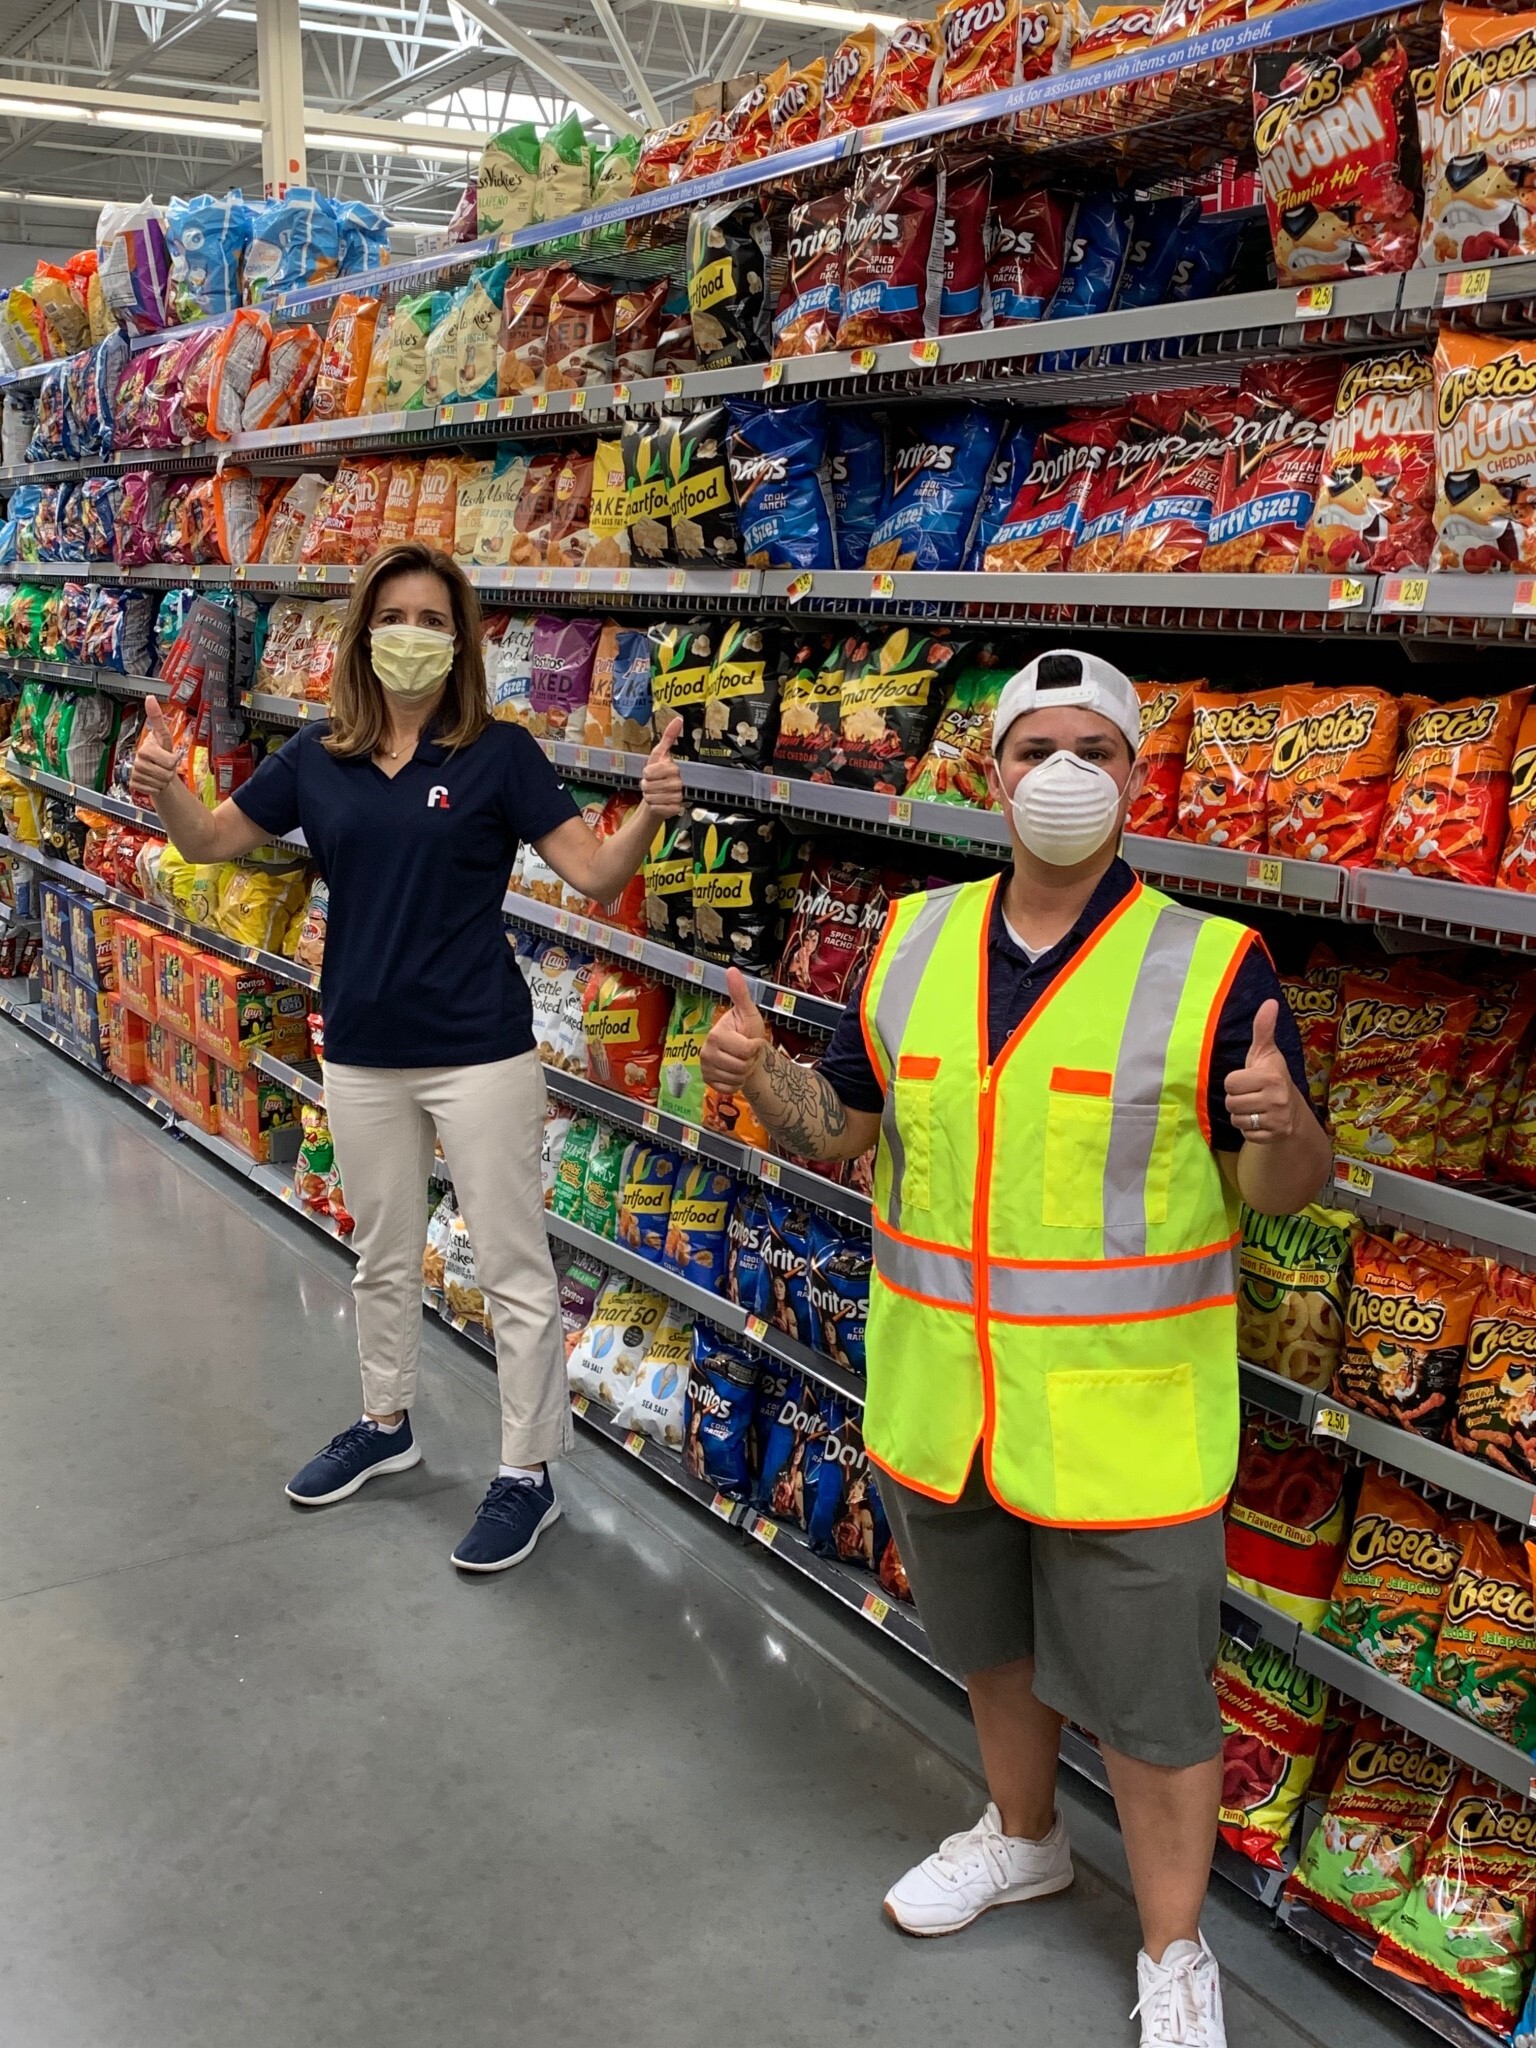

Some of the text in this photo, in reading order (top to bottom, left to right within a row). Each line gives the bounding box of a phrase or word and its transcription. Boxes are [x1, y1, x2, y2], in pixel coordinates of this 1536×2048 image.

[1005, 20, 1273, 108] Ask for assistance with items on the top shelf.
[1496, 133, 1536, 157] CHEDD
[1275, 162, 1369, 213] Flamin' Hot
[581, 215, 593, 228] Ask
[594, 211, 602, 223] for
[602, 204, 636, 221] assistance
[636, 198, 651, 213] with
[651, 193, 670, 208] items
[670, 190, 681, 202] on
[680, 187, 692, 199] the
[704, 174, 725, 192] shelf.
[847, 212, 900, 243] oritos
[825, 262, 840, 273] SPI
[866, 264, 894, 275] NACHO
[870, 255, 895, 265] SPICY
[998, 265, 1025, 276] SPICY
[992, 272, 1023, 284] NACHO
[1464, 272, 1486, 295] 2.50
[850, 283, 882, 312] Size!
[1336, 351, 1435, 417] Cheetos
[1023, 444, 1106, 486] Doritos
[1331, 444, 1382, 468] Flamin'
[1487, 448, 1536, 474] CHEDDA
[913, 487, 940, 498] RANCH
[921, 479, 941, 489] COOL
[759, 499, 787, 511] RANCH
[764, 493, 787, 503] COOL
[1250, 491, 1299, 520] Size!
[894, 505, 923, 531] Size!
[752, 518, 779, 546] Size!
[1404, 581, 1424, 601] 2.50
[531, 672, 573, 694] AKED
[1269, 701, 1378, 777] Cheetos
[1295, 757, 1345, 785] Crunchy
[1262, 863, 1279, 882] 2.50
[823, 937, 853, 950] NACHO
[830, 930, 855, 942] SPICY
[237, 978, 266, 991] Doritos
[530, 976, 562, 997] Kettle
[531, 998, 562, 1015] ooked
[562, 1011, 585, 1031] ooked
[1338, 998, 1447, 1049] Cheetos
[1352, 1165, 1371, 1187] 2.50
[623, 1188, 664, 1211] artfood
[760, 1233, 807, 1277] Dorito
[1240, 1256, 1326, 1285] nion Flavored Rings
[1365, 1273, 1391, 1285] TWICE
[561, 1287, 585, 1306] Doritos
[593, 1305, 658, 1326] mart 50
[1347, 1286, 1445, 1341] Cheetos
[847, 1333, 865, 1341] RAN
[581, 1359, 604, 1375] SEA SALT
[642, 1399, 669, 1417] SEA SALT
[778, 1400, 828, 1434] Dorito
[710, 1421, 730, 1432] COOL
[1327, 1410, 1345, 1431] 2.50
[1230, 1504, 1313, 1543] nion Flavored Rings
[1348, 1516, 1458, 1578] Cheetos
[1386, 1573, 1441, 1596] Jalapeño
[1370, 1588, 1403, 1603] Crunchy
[1448, 1568, 1536, 1627] Cheeto
[1481, 1630, 1536, 1651] Jalapeñ
[1465, 1644, 1500, 1659] Crunchy
[1254, 1707, 1290, 1734] Hot
[1347, 1740, 1455, 1793] Cheetos
[1339, 1795, 1408, 1814] Flamin' Hot
[1488, 1862, 1514, 1876] Hot
